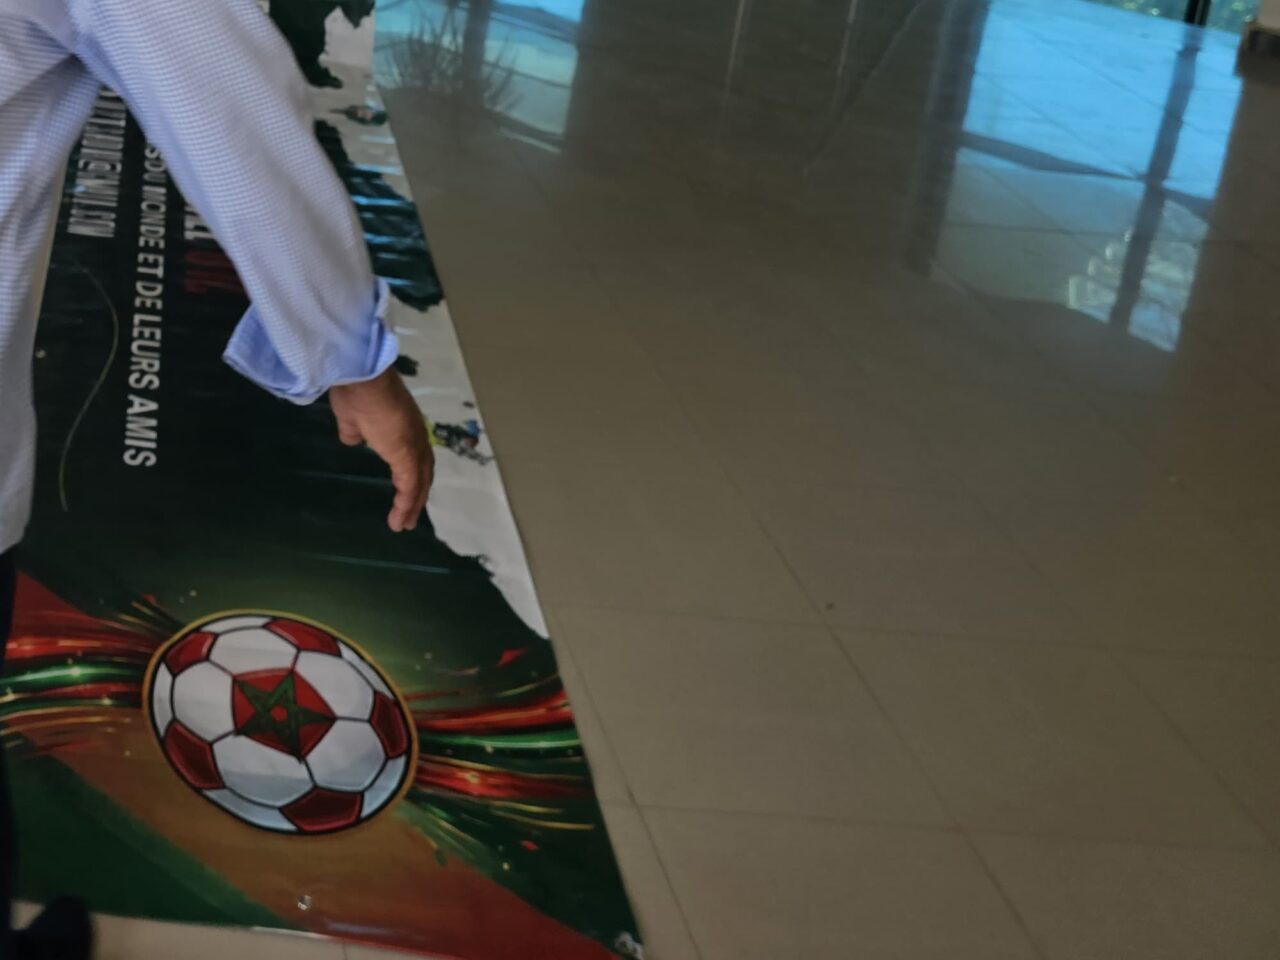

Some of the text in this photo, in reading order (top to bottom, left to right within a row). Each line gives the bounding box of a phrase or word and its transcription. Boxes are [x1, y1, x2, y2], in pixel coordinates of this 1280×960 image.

[138, 185, 167, 249] MONDE
[134, 281, 164, 310] DE
[136, 252, 165, 279] ET
[128, 313, 163, 390] LEURS
[123, 394, 159, 467] AMIS
